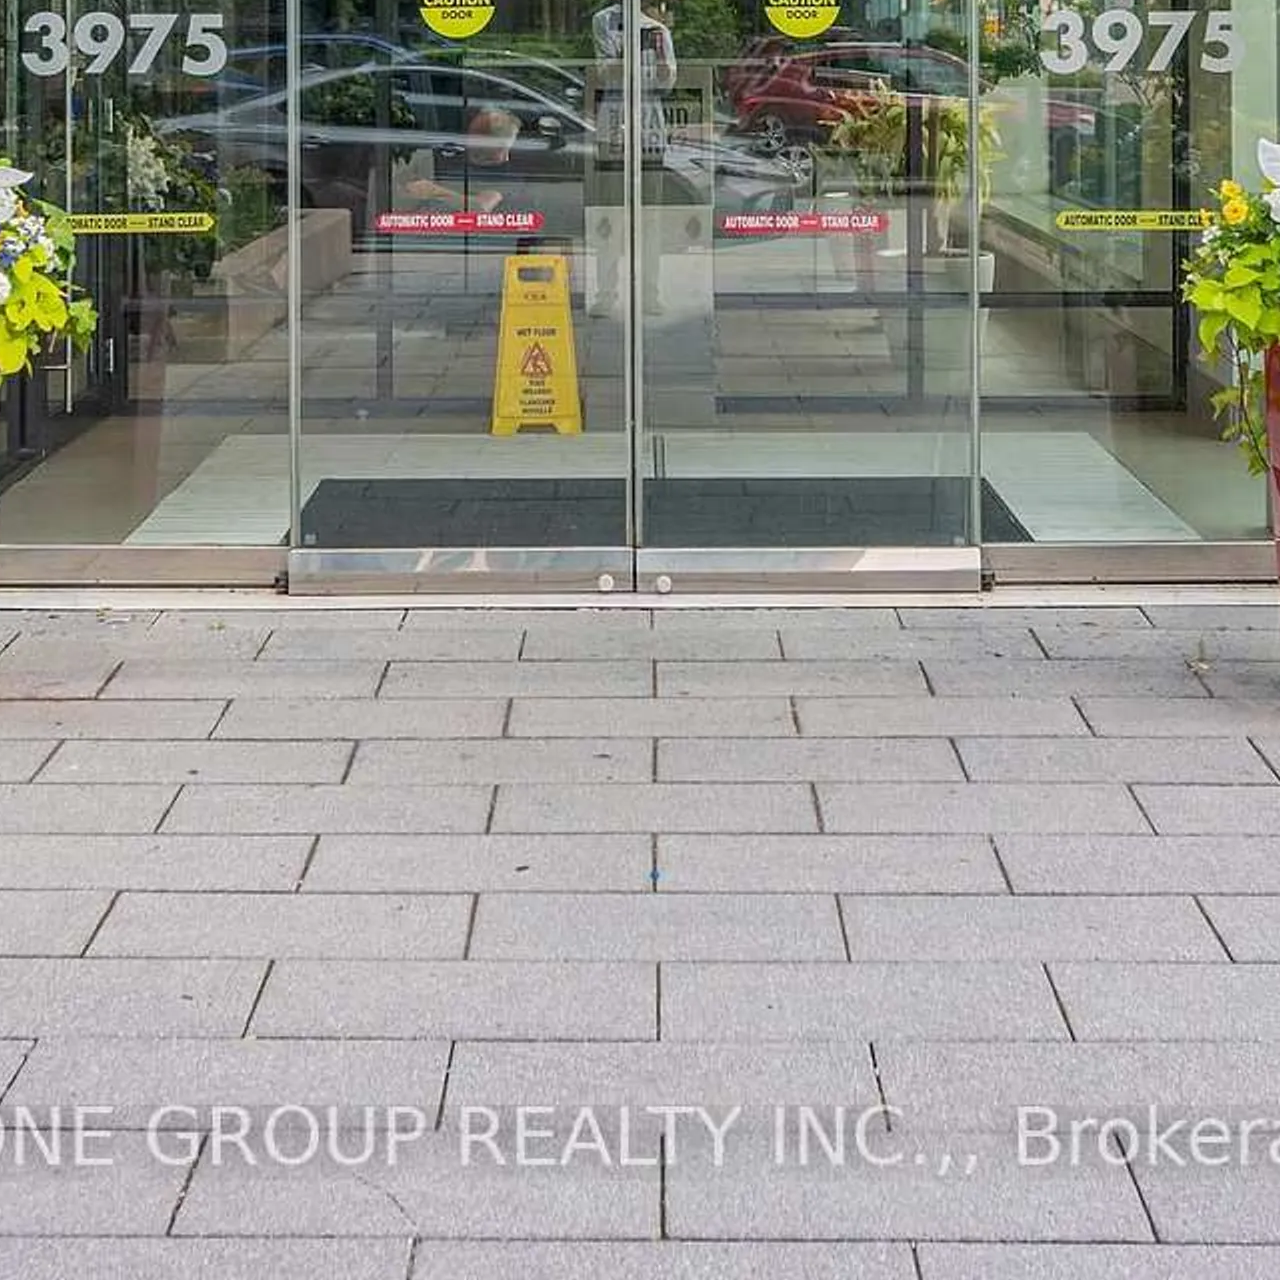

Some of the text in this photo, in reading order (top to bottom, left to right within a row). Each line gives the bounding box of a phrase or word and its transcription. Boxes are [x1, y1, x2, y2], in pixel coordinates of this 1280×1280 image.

[441, 10, 474, 19] DOOR
[786, 10, 818, 19] DOOR
[21, 11, 228, 77] 3975
[1039, 9, 1246, 74] 3975
[104, 217, 127, 229] DOOR
[148, 216, 175, 228] STAND
[178, 215, 204, 227] CLEAR
[379, 213, 533, 228] AUTOMATIC DOOR STAND CLEAR
[725, 215, 879, 229] AUTOMATIC DOOR STAND CLEAR
[1064, 214, 1113, 226] AUTOMATIC
[1114, 214, 1137, 226] DOOR
[1159, 214, 1185, 226] STAND
